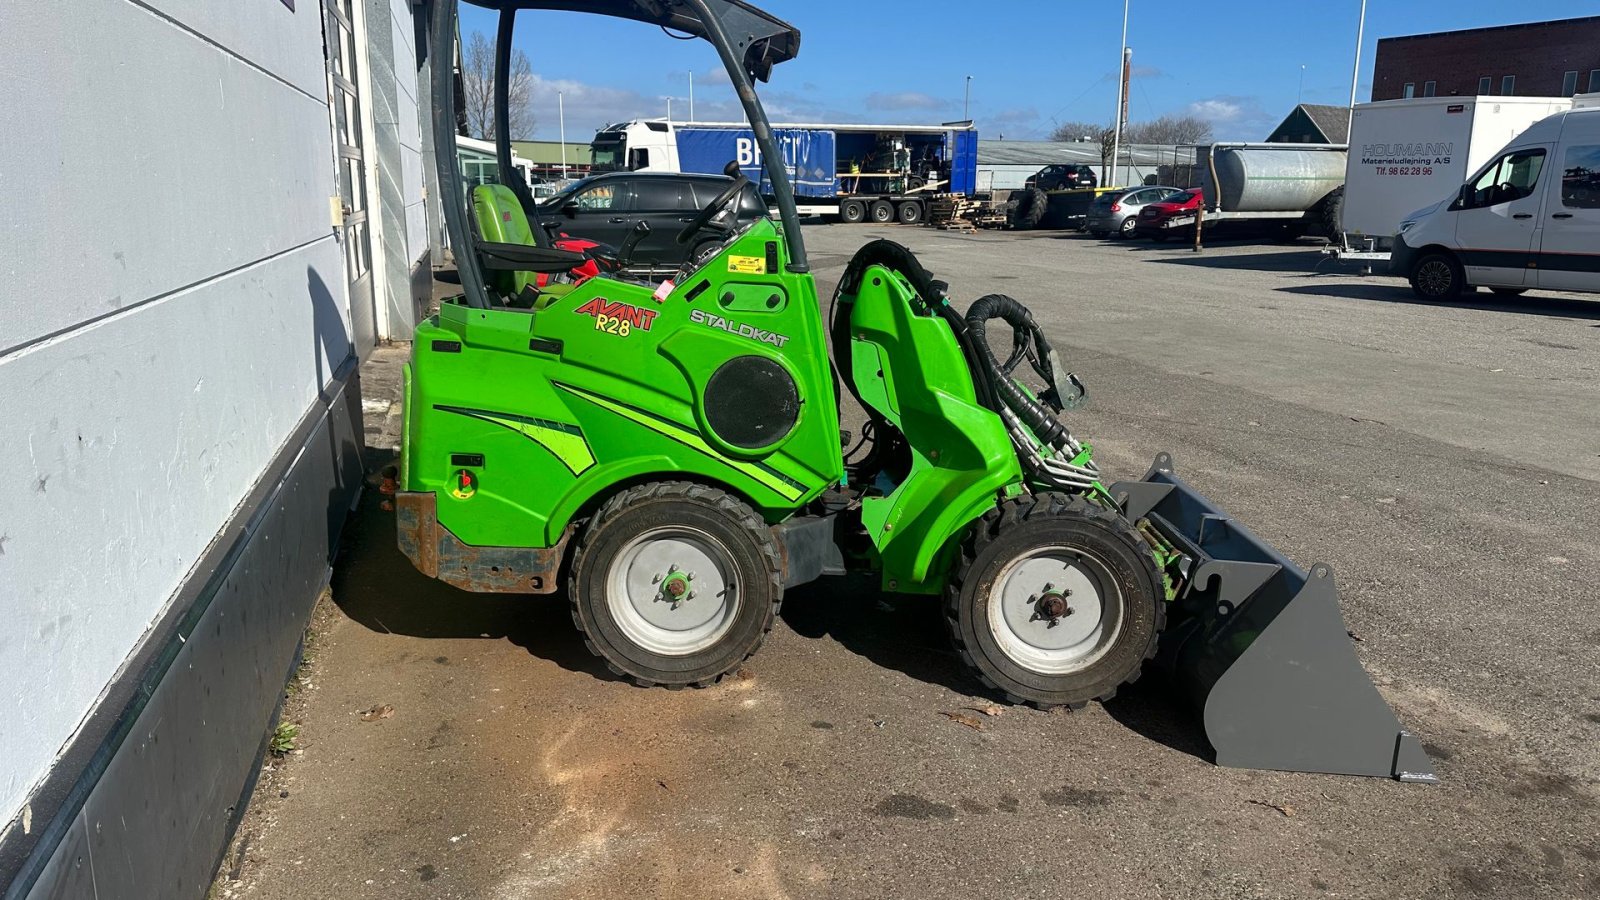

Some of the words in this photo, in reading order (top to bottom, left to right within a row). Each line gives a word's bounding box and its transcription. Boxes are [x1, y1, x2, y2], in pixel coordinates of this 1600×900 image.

[1362, 142, 1453, 157] HOUMANN
[1361, 157, 1431, 165] Materieludlejning
[1434, 157, 1451, 165] A/S
[1376, 167, 1387, 175] Tlf.
[1389, 167, 1398, 175] 98
[1399, 167, 1409, 175] 62
[1411, 167, 1421, 175] 28
[1422, 167, 1433, 175] 96
[574, 297, 657, 331] AVANT
[595, 313, 631, 337] R28
[689, 308, 790, 348] STALDKAT
